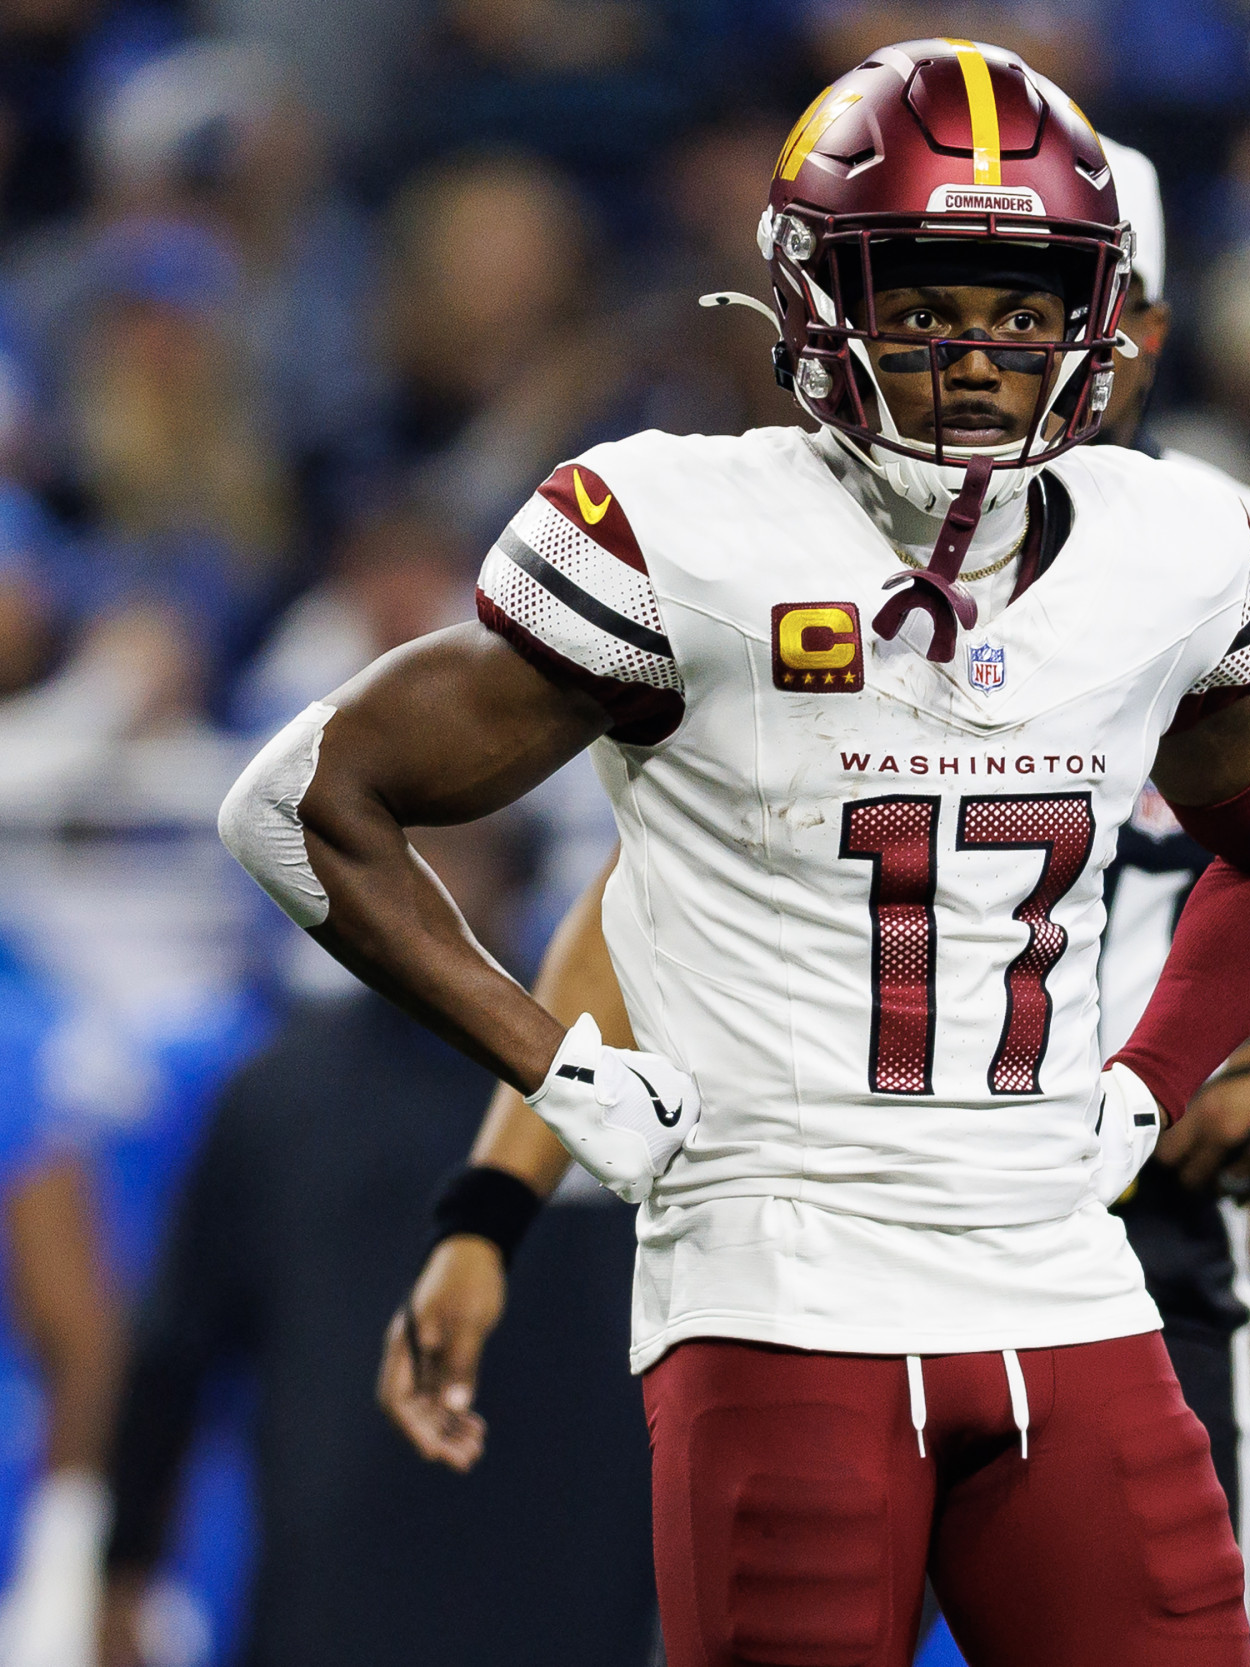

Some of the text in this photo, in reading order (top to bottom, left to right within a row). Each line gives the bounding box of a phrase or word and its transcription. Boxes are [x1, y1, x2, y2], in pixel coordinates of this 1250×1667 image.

[945, 194, 1033, 212] COMMANDERS
[779, 608, 856, 670] C
[974, 663, 1001, 685] NFL
[840, 752, 1106, 775] WASHINGTON
[838, 791, 1097, 1095] 17
